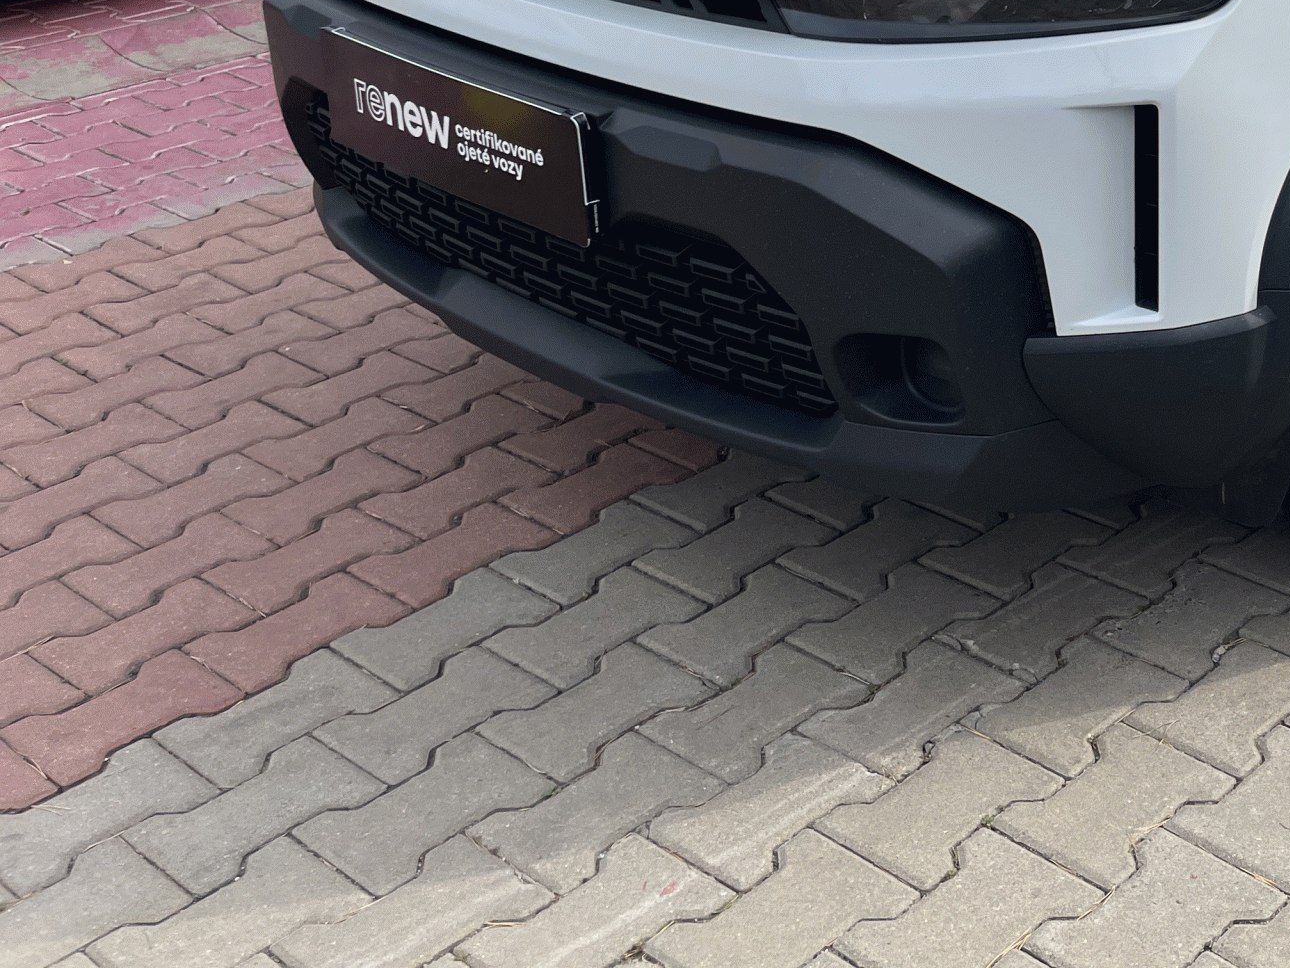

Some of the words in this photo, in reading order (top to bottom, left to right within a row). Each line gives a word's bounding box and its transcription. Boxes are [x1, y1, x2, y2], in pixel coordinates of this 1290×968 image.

[354, 78, 451, 150] renew
[455, 123, 544, 167] certifikované
[457, 142, 491, 167] ojeté
[493, 153, 524, 181] vozy
